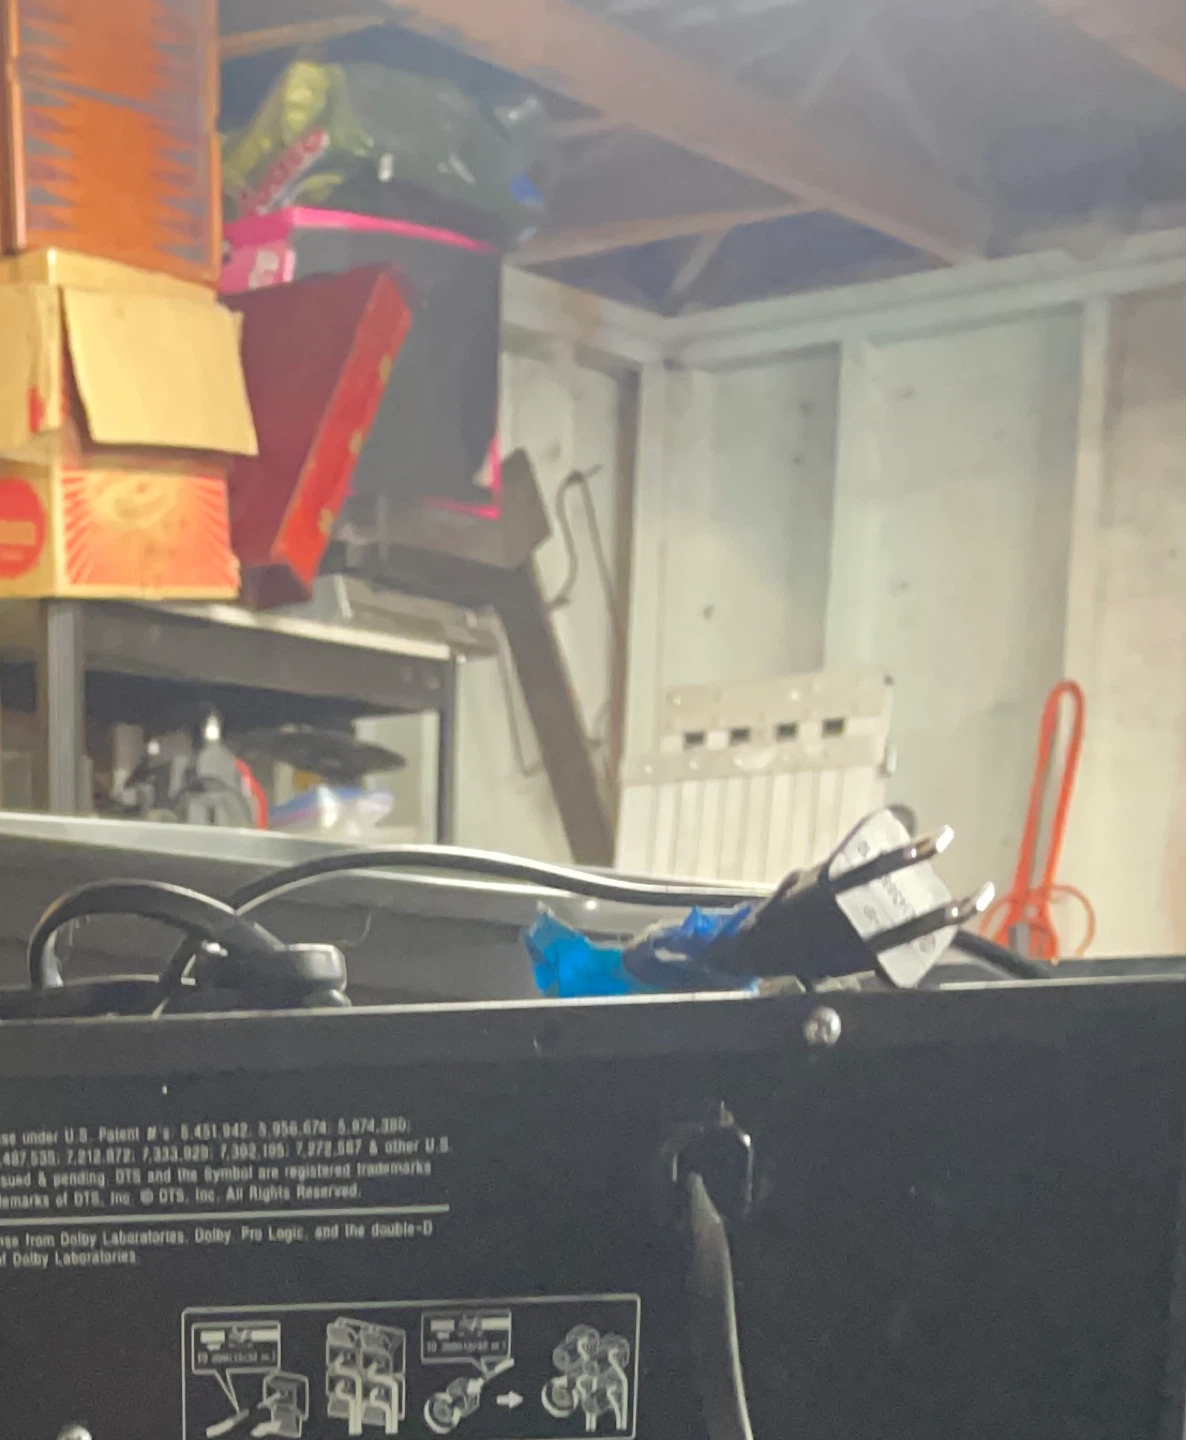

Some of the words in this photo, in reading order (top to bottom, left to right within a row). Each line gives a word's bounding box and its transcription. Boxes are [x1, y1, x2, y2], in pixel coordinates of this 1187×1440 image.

[22, 1129, 58, 1145] under
[99, 1126, 140, 1143] Patent
[385, 1138, 419, 1154] other
[38, 1170, 47, 1187] &
[53, 1171, 105, 1189] pending
[147, 1168, 171, 1184] and
[177, 1167, 198, 1183] the
[258, 1166, 279, 1180] are
[285, 1161, 351, 1182] registered
[357, 1160, 432, 1177] trademarks
[56, 1190, 68, 1208] of
[226, 1184, 243, 1201] All
[250, 1184, 290, 1203] Rights
[297, 1181, 361, 1200] Reserved.
[25, 1232, 55, 1247] from
[61, 1230, 97, 1248] Dolby
[195, 1227, 231, 1246] Dolby
[241, 1226, 262, 1242] Pro
[315, 1224, 338, 1240] and
[345, 1223, 364, 1238] the
[371, 1220, 433, 1238] double-D
[13, 1251, 48, 1269] Dolby
